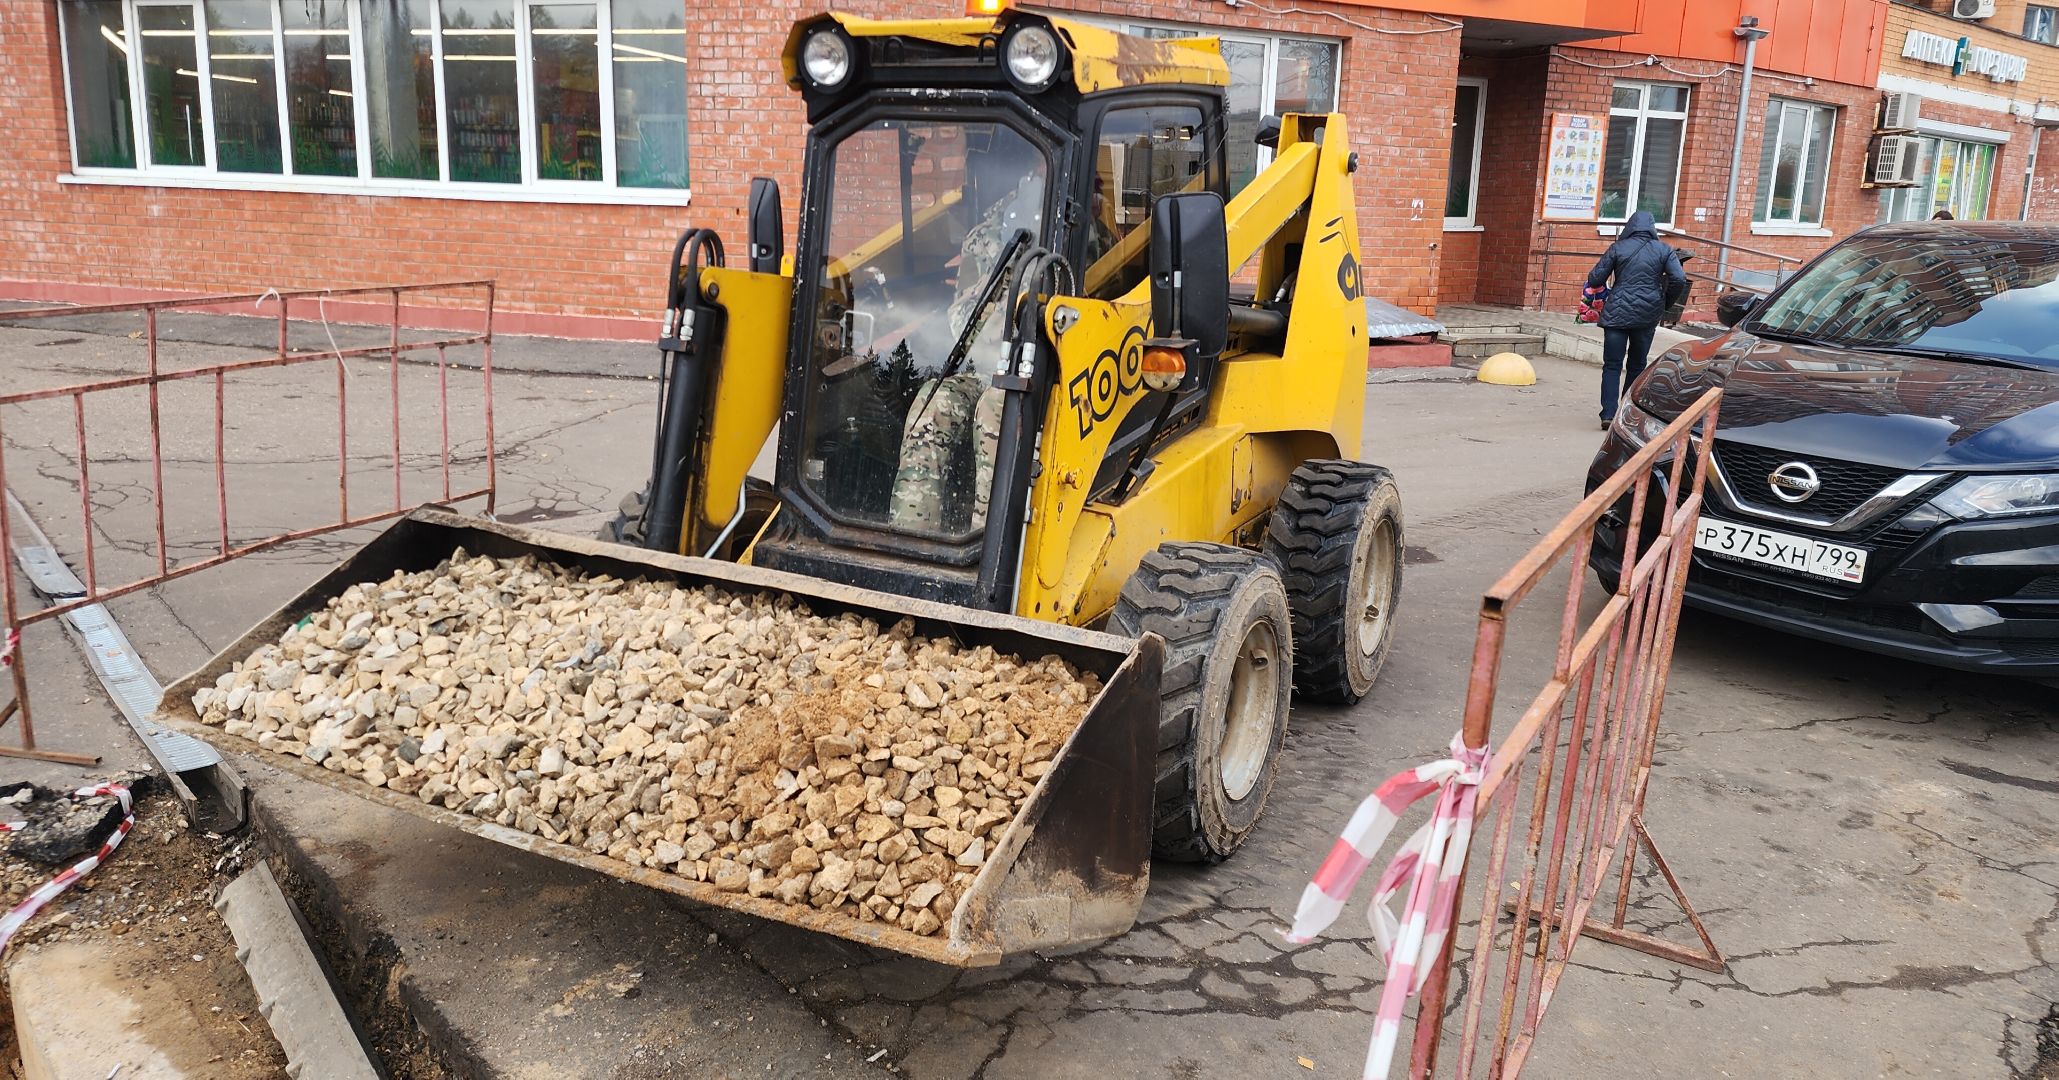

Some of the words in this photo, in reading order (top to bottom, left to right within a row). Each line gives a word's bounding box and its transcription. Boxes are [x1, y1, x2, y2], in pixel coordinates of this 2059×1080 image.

[1069, 315, 1155, 440] 100
[1772, 475, 1813, 489] NISSAN
[1712, 552, 1744, 564] NISSAN
[1816, 544, 1858, 569] 799
[1822, 565, 1843, 576] RUS
